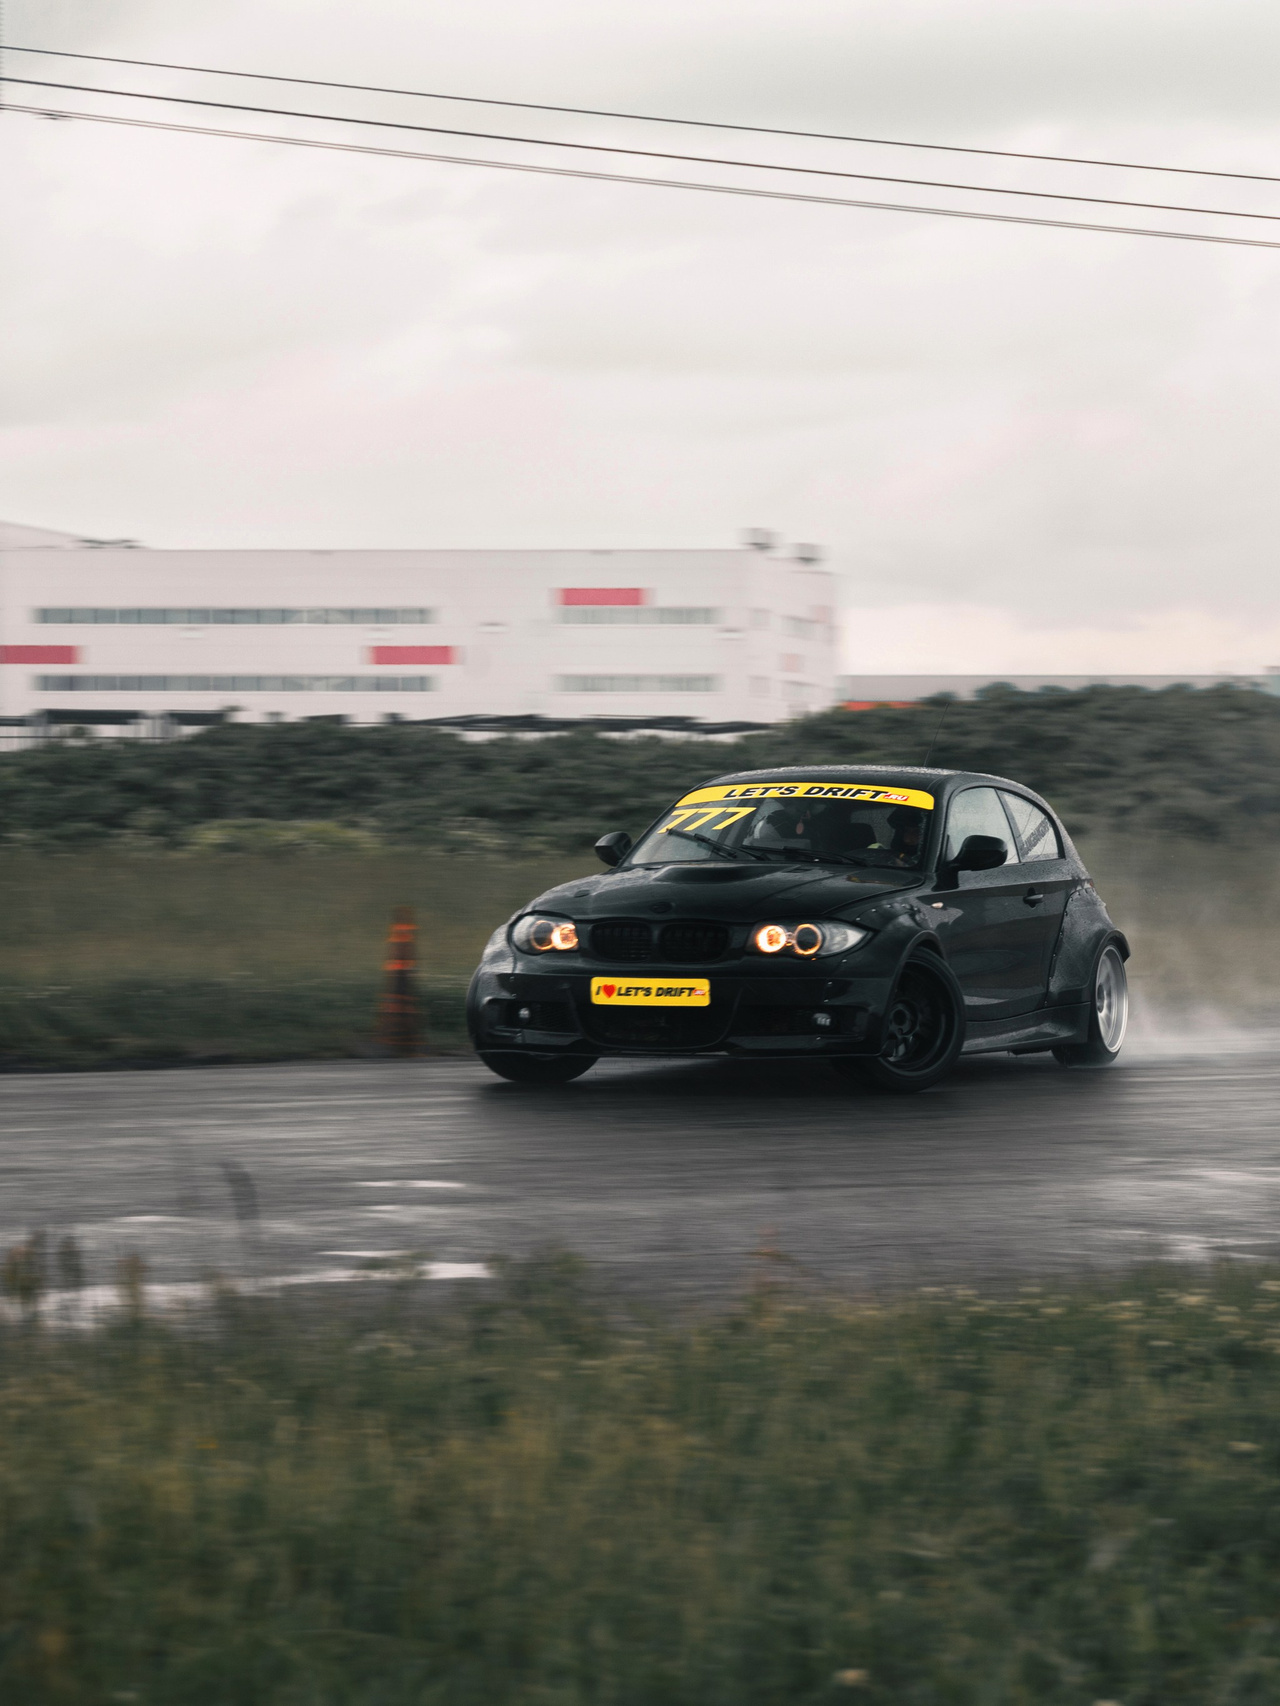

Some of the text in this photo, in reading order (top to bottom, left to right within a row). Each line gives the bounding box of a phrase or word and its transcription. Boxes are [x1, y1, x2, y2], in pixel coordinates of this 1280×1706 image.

[723, 786, 799, 799] LET'S
[657, 807, 757, 834] 777
[617, 986, 652, 996] LET'S
